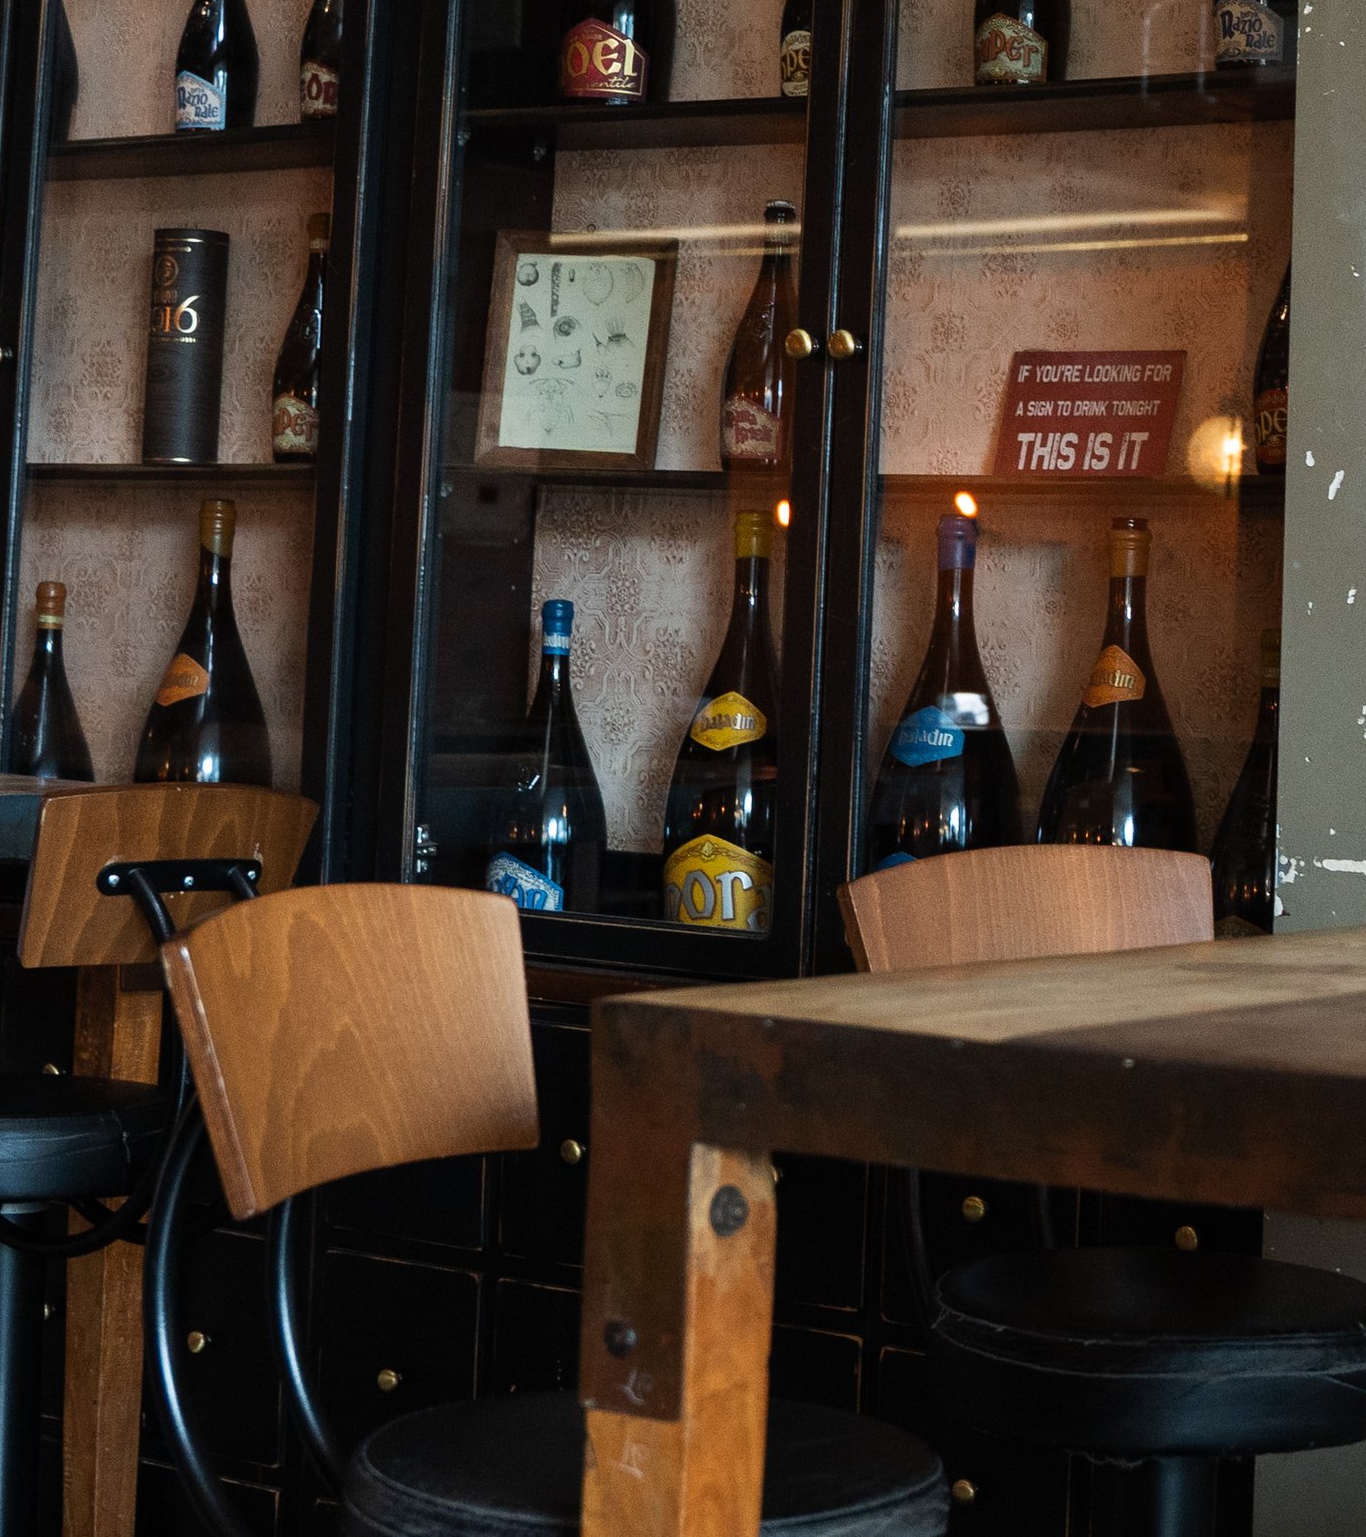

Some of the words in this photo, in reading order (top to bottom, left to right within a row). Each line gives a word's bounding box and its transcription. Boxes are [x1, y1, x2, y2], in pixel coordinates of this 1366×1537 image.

[1018, 365, 1032, 383] IF
[1035, 365, 1081, 383] YOU'RE
[1084, 365, 1142, 383] LOOKING
[1143, 364, 1172, 382] FOR
[1015, 400, 1025, 417] A
[1026, 401, 1053, 417] SIGN
[1056, 400, 1072, 417] TO
[1073, 400, 1108, 417] DRINK
[1112, 400, 1162, 417] TONIGHT
[1017, 432, 1079, 471] THIS
[1082, 432, 1114, 471] IS
[1117, 432, 1150, 471] IT
